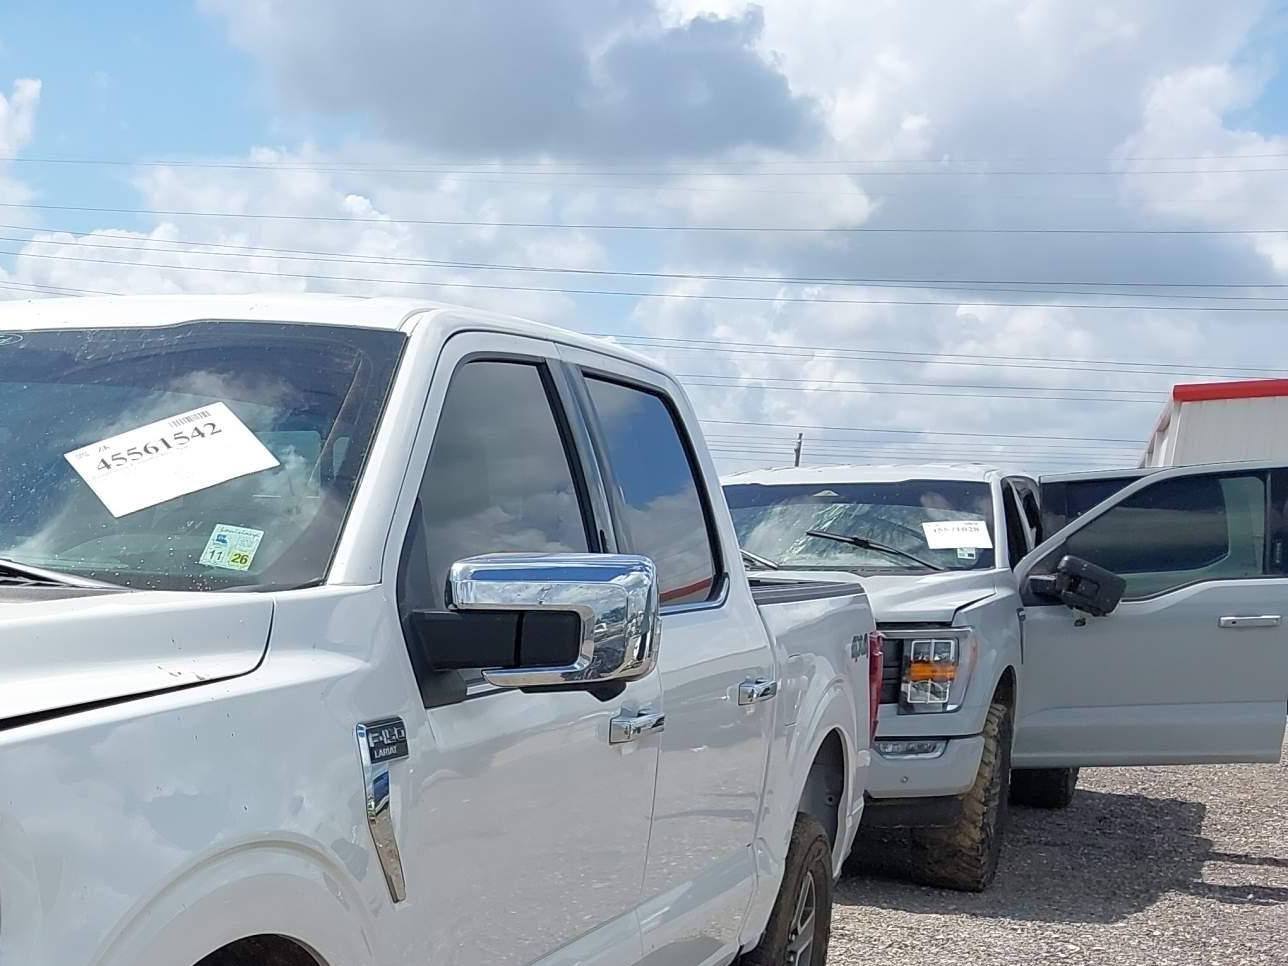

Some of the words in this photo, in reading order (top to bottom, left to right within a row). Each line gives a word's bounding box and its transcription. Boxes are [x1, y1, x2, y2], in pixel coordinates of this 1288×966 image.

[97, 422, 222, 471] 45561542
[209, 550, 223, 561] 11
[231, 553, 249, 565] 26
